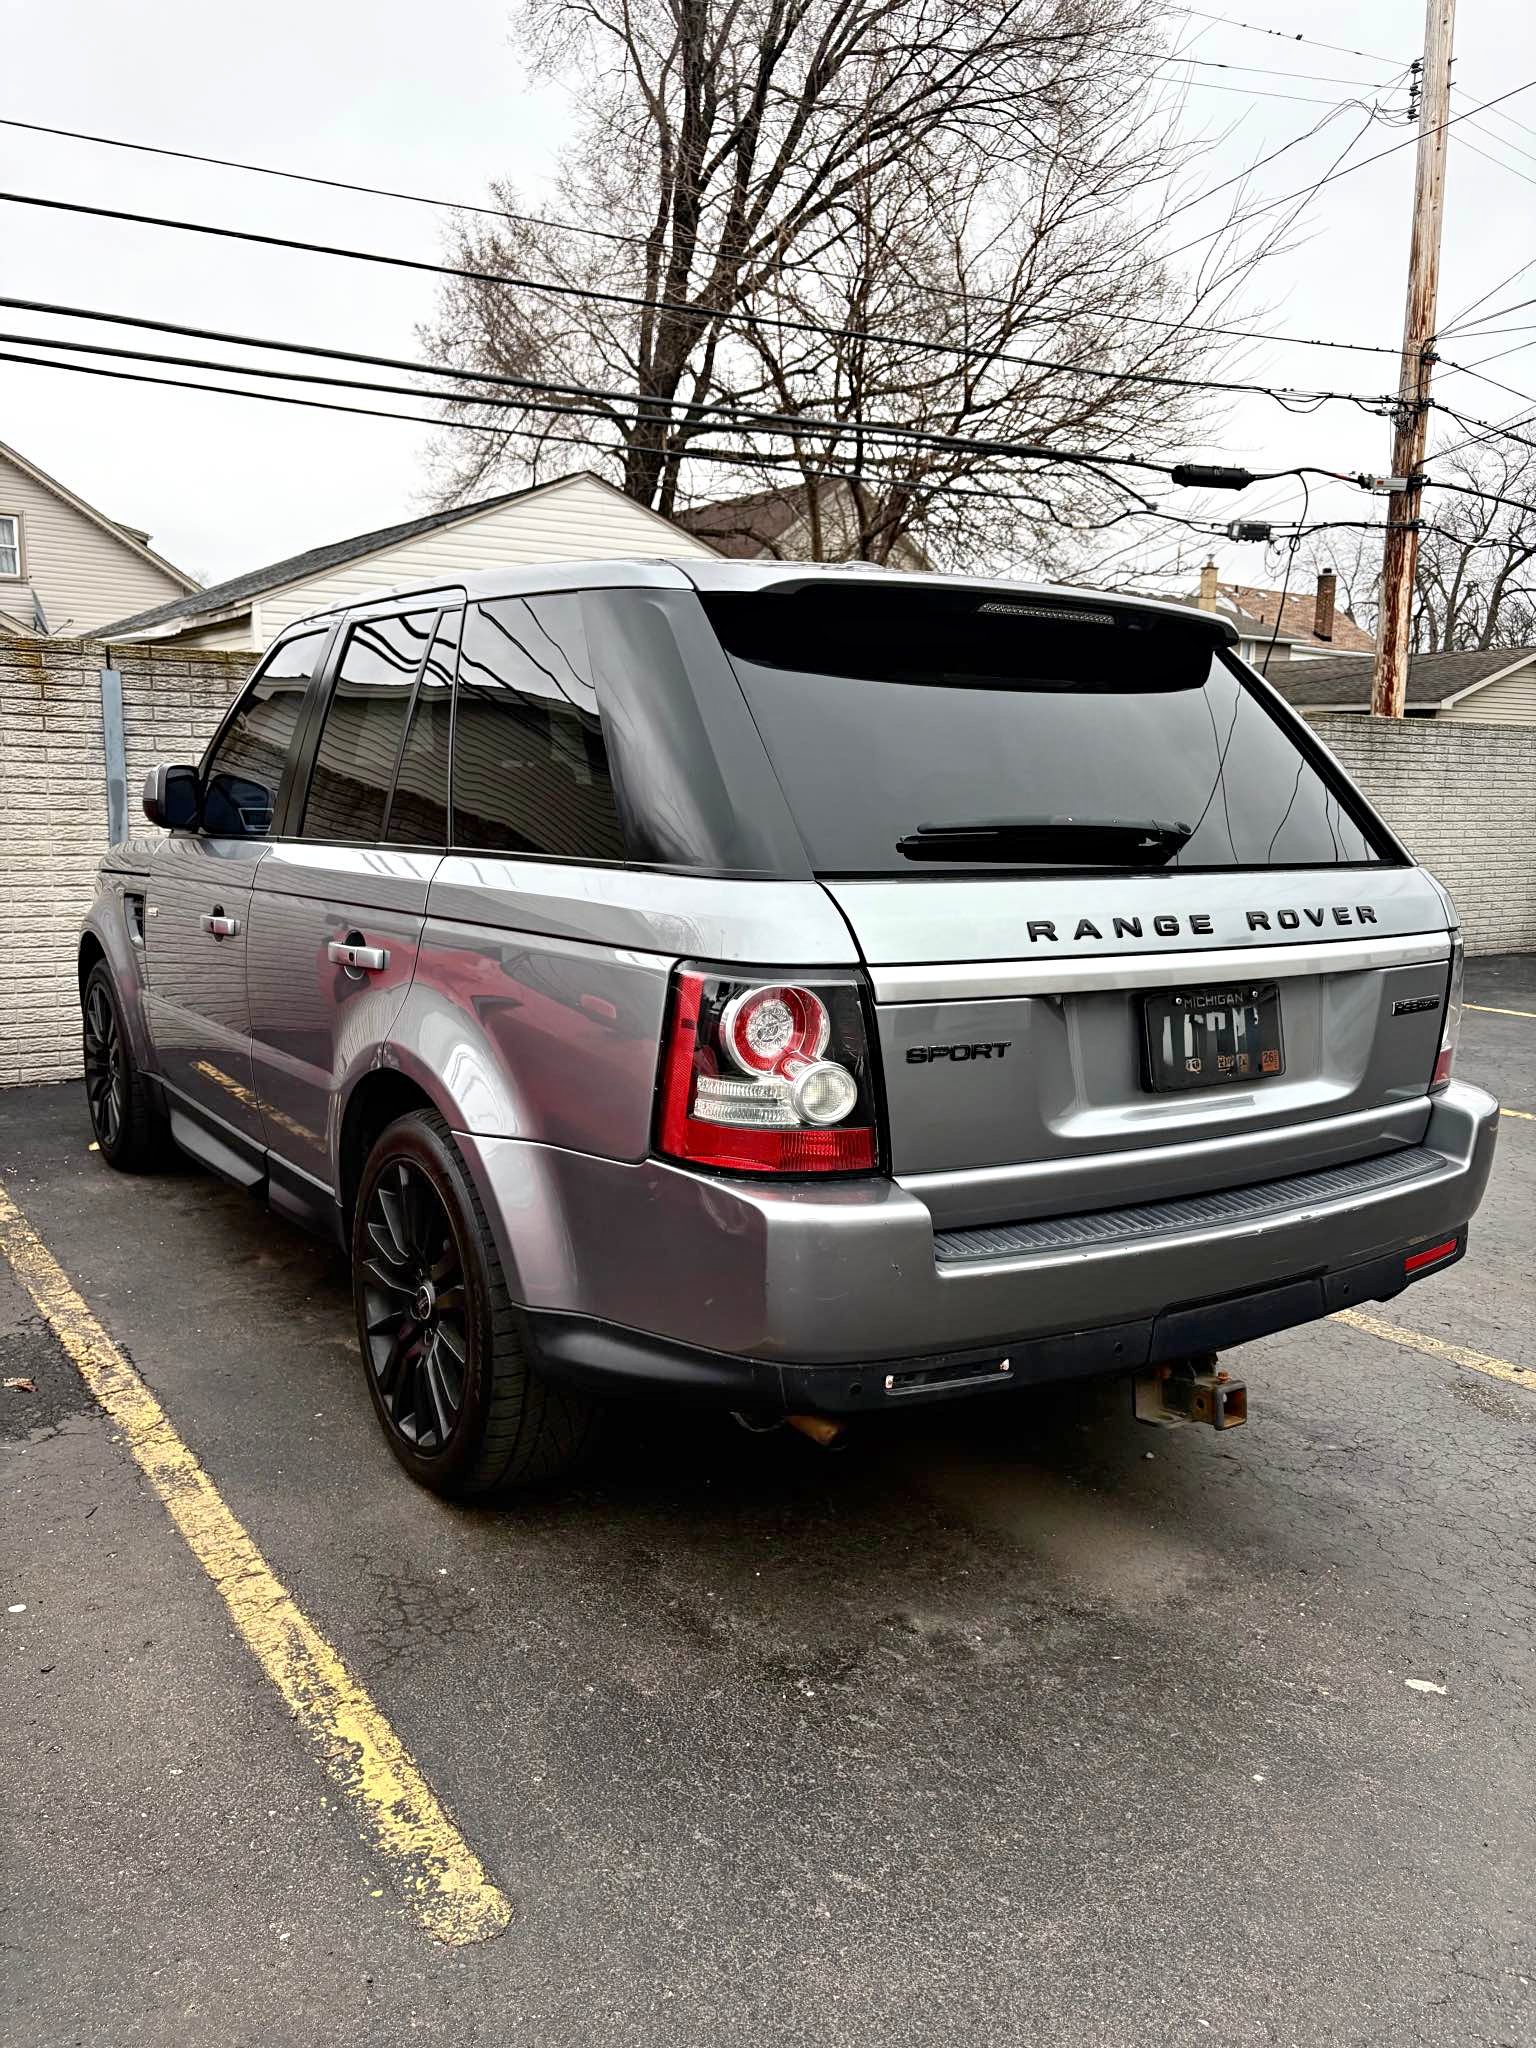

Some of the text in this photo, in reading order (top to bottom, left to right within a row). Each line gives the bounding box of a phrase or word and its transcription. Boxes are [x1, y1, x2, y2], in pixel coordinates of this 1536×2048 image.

[1026, 905, 1379, 943] RANGE ROVER
[1184, 993, 1244, 1009] MICHIGAN
[906, 1041, 1012, 1064] SPORT
